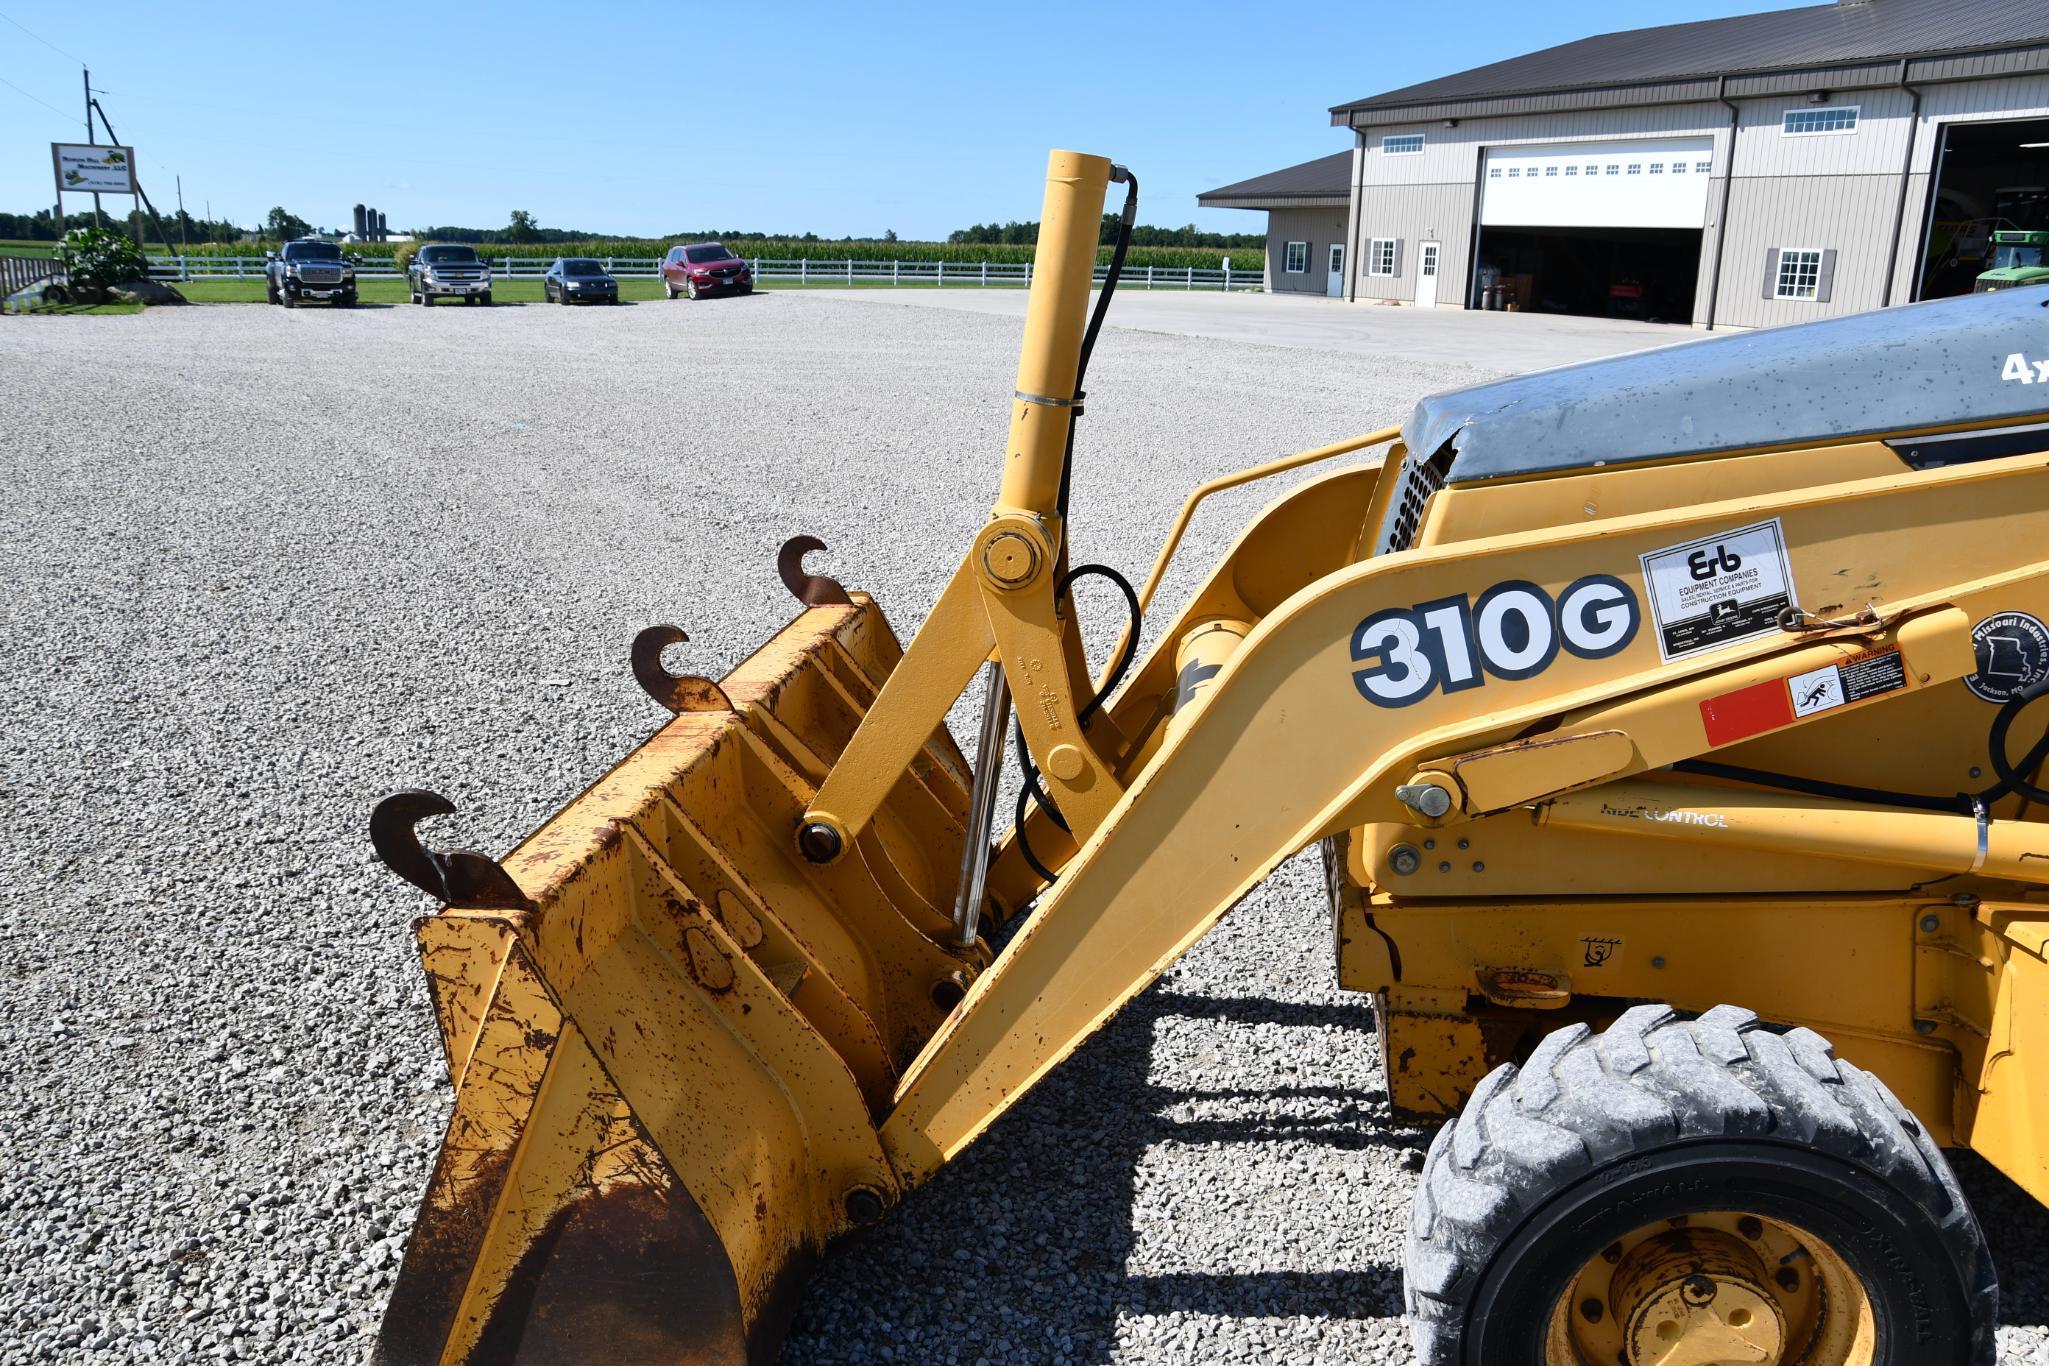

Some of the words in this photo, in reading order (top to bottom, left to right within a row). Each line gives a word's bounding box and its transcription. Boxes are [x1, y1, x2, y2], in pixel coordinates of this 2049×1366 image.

[1687, 544, 1742, 581] Erb
[1678, 578, 1718, 596] EQUIPMENT
[1719, 567, 1759, 585] COMPANIES
[1680, 590, 1727, 609] CONSTRUCTION
[1727, 582, 1762, 597] EQUIPMENT
[1354, 577, 1637, 704] 310G
[1851, 643, 1896, 662] WARNING
[1974, 617, 2018, 641] Missouri
[2019, 618, 2049, 665] Industries,
[1979, 682, 2009, 697] Jackson,
[2011, 685, 2024, 695] MO
